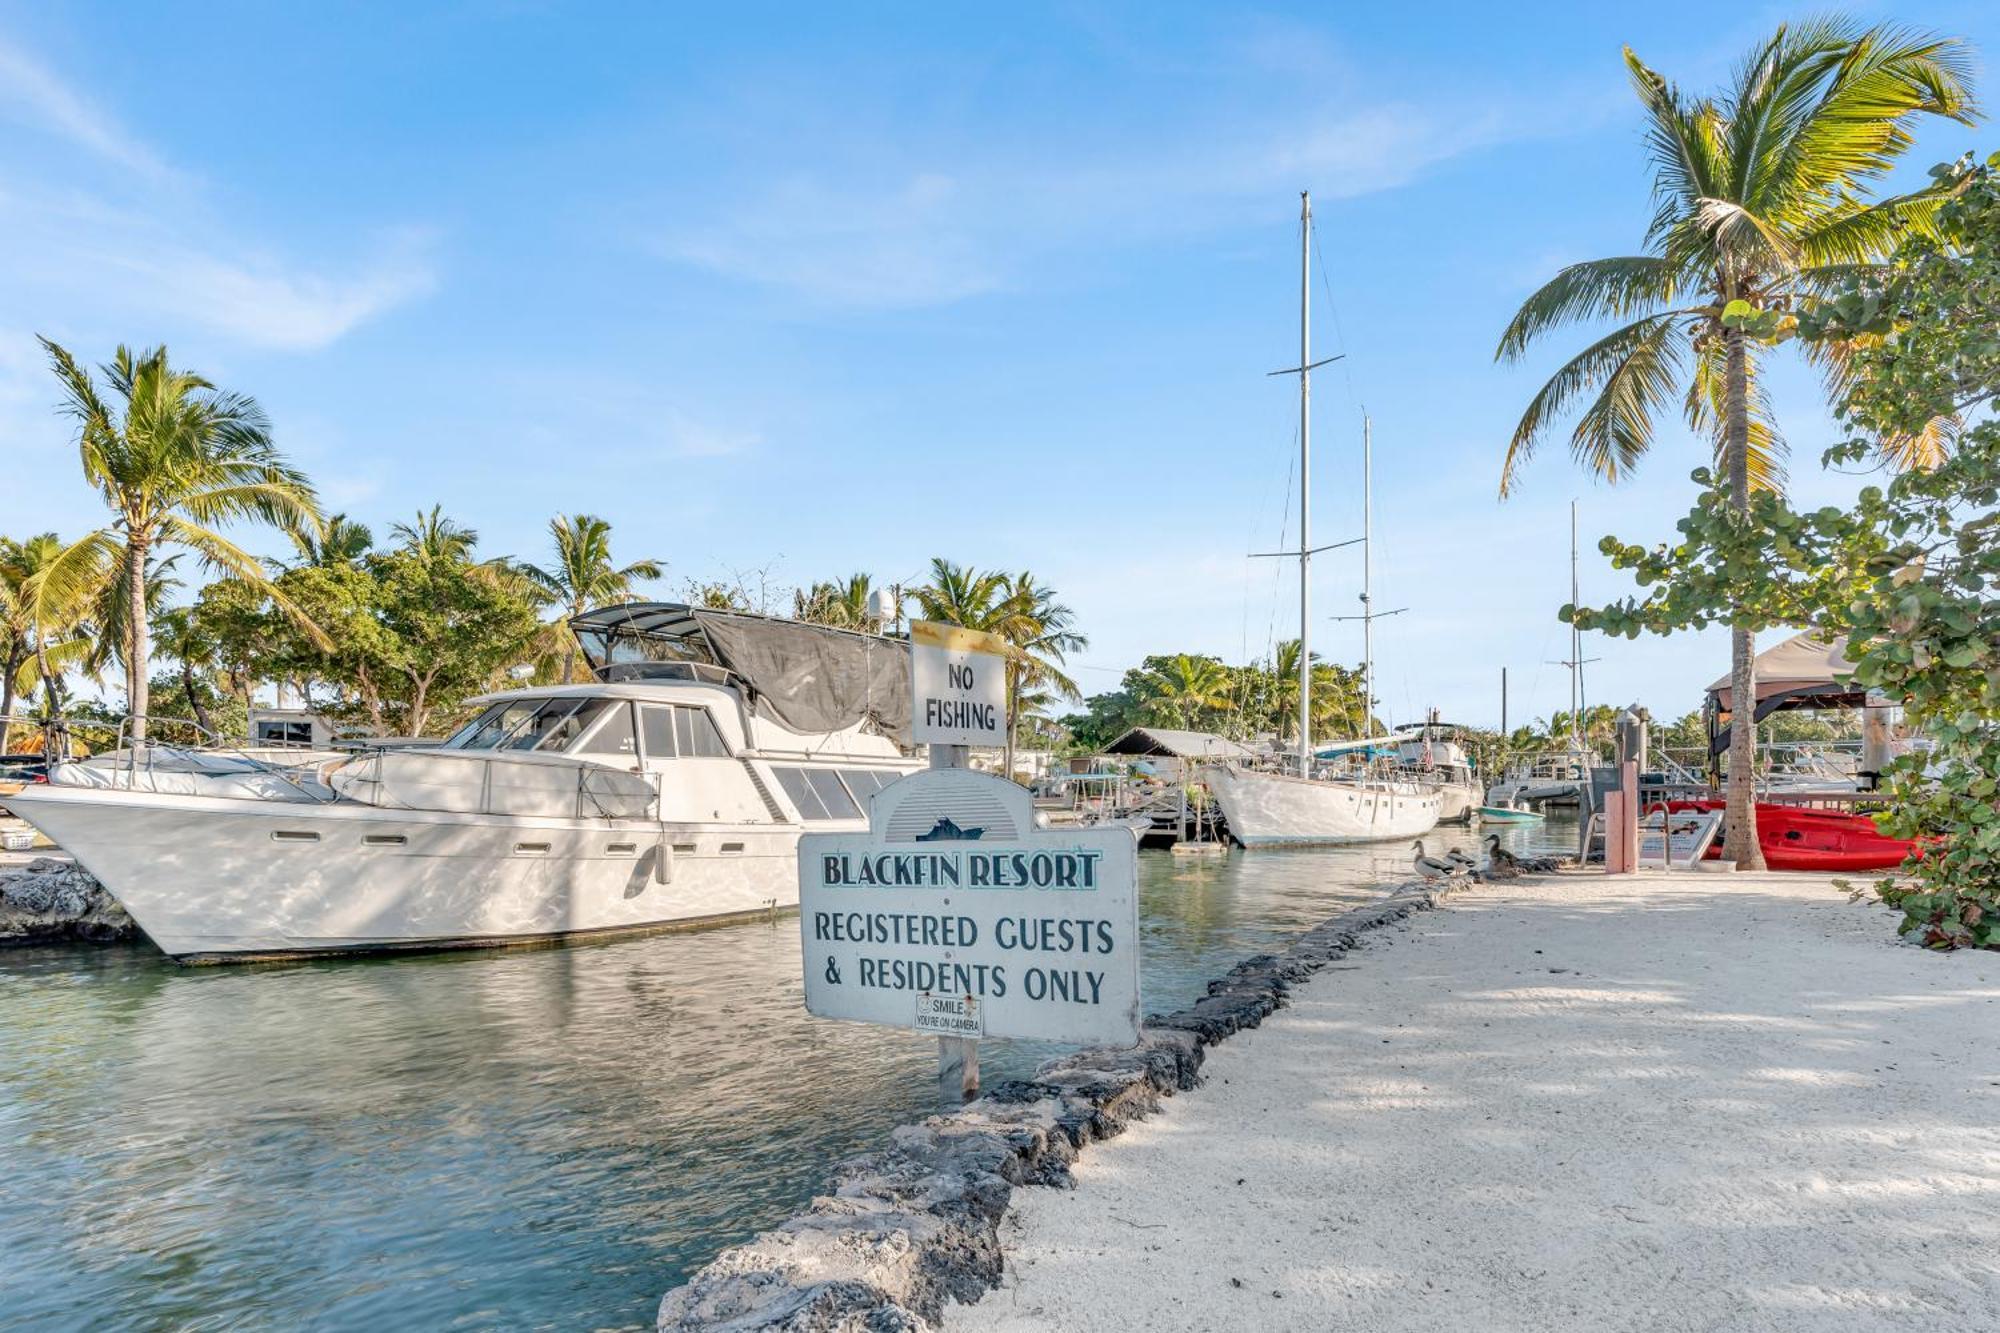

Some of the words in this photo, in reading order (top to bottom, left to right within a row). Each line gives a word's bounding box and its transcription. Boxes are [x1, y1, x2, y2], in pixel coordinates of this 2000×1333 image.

[949, 663, 974, 690] NO
[926, 698, 996, 731] FISHING
[823, 854, 960, 886] BLACKFIN
[969, 853, 1100, 888] RESORT
[815, 911, 978, 947] REGISTERED
[995, 917, 1114, 954] GUESTS
[825, 955, 842, 984] &
[859, 958, 1007, 998] RESIDENTS
[1023, 967, 1105, 1005] ONLY
[940, 1016, 950, 1028] ON
[950, 1018, 979, 1031] CAMERA
